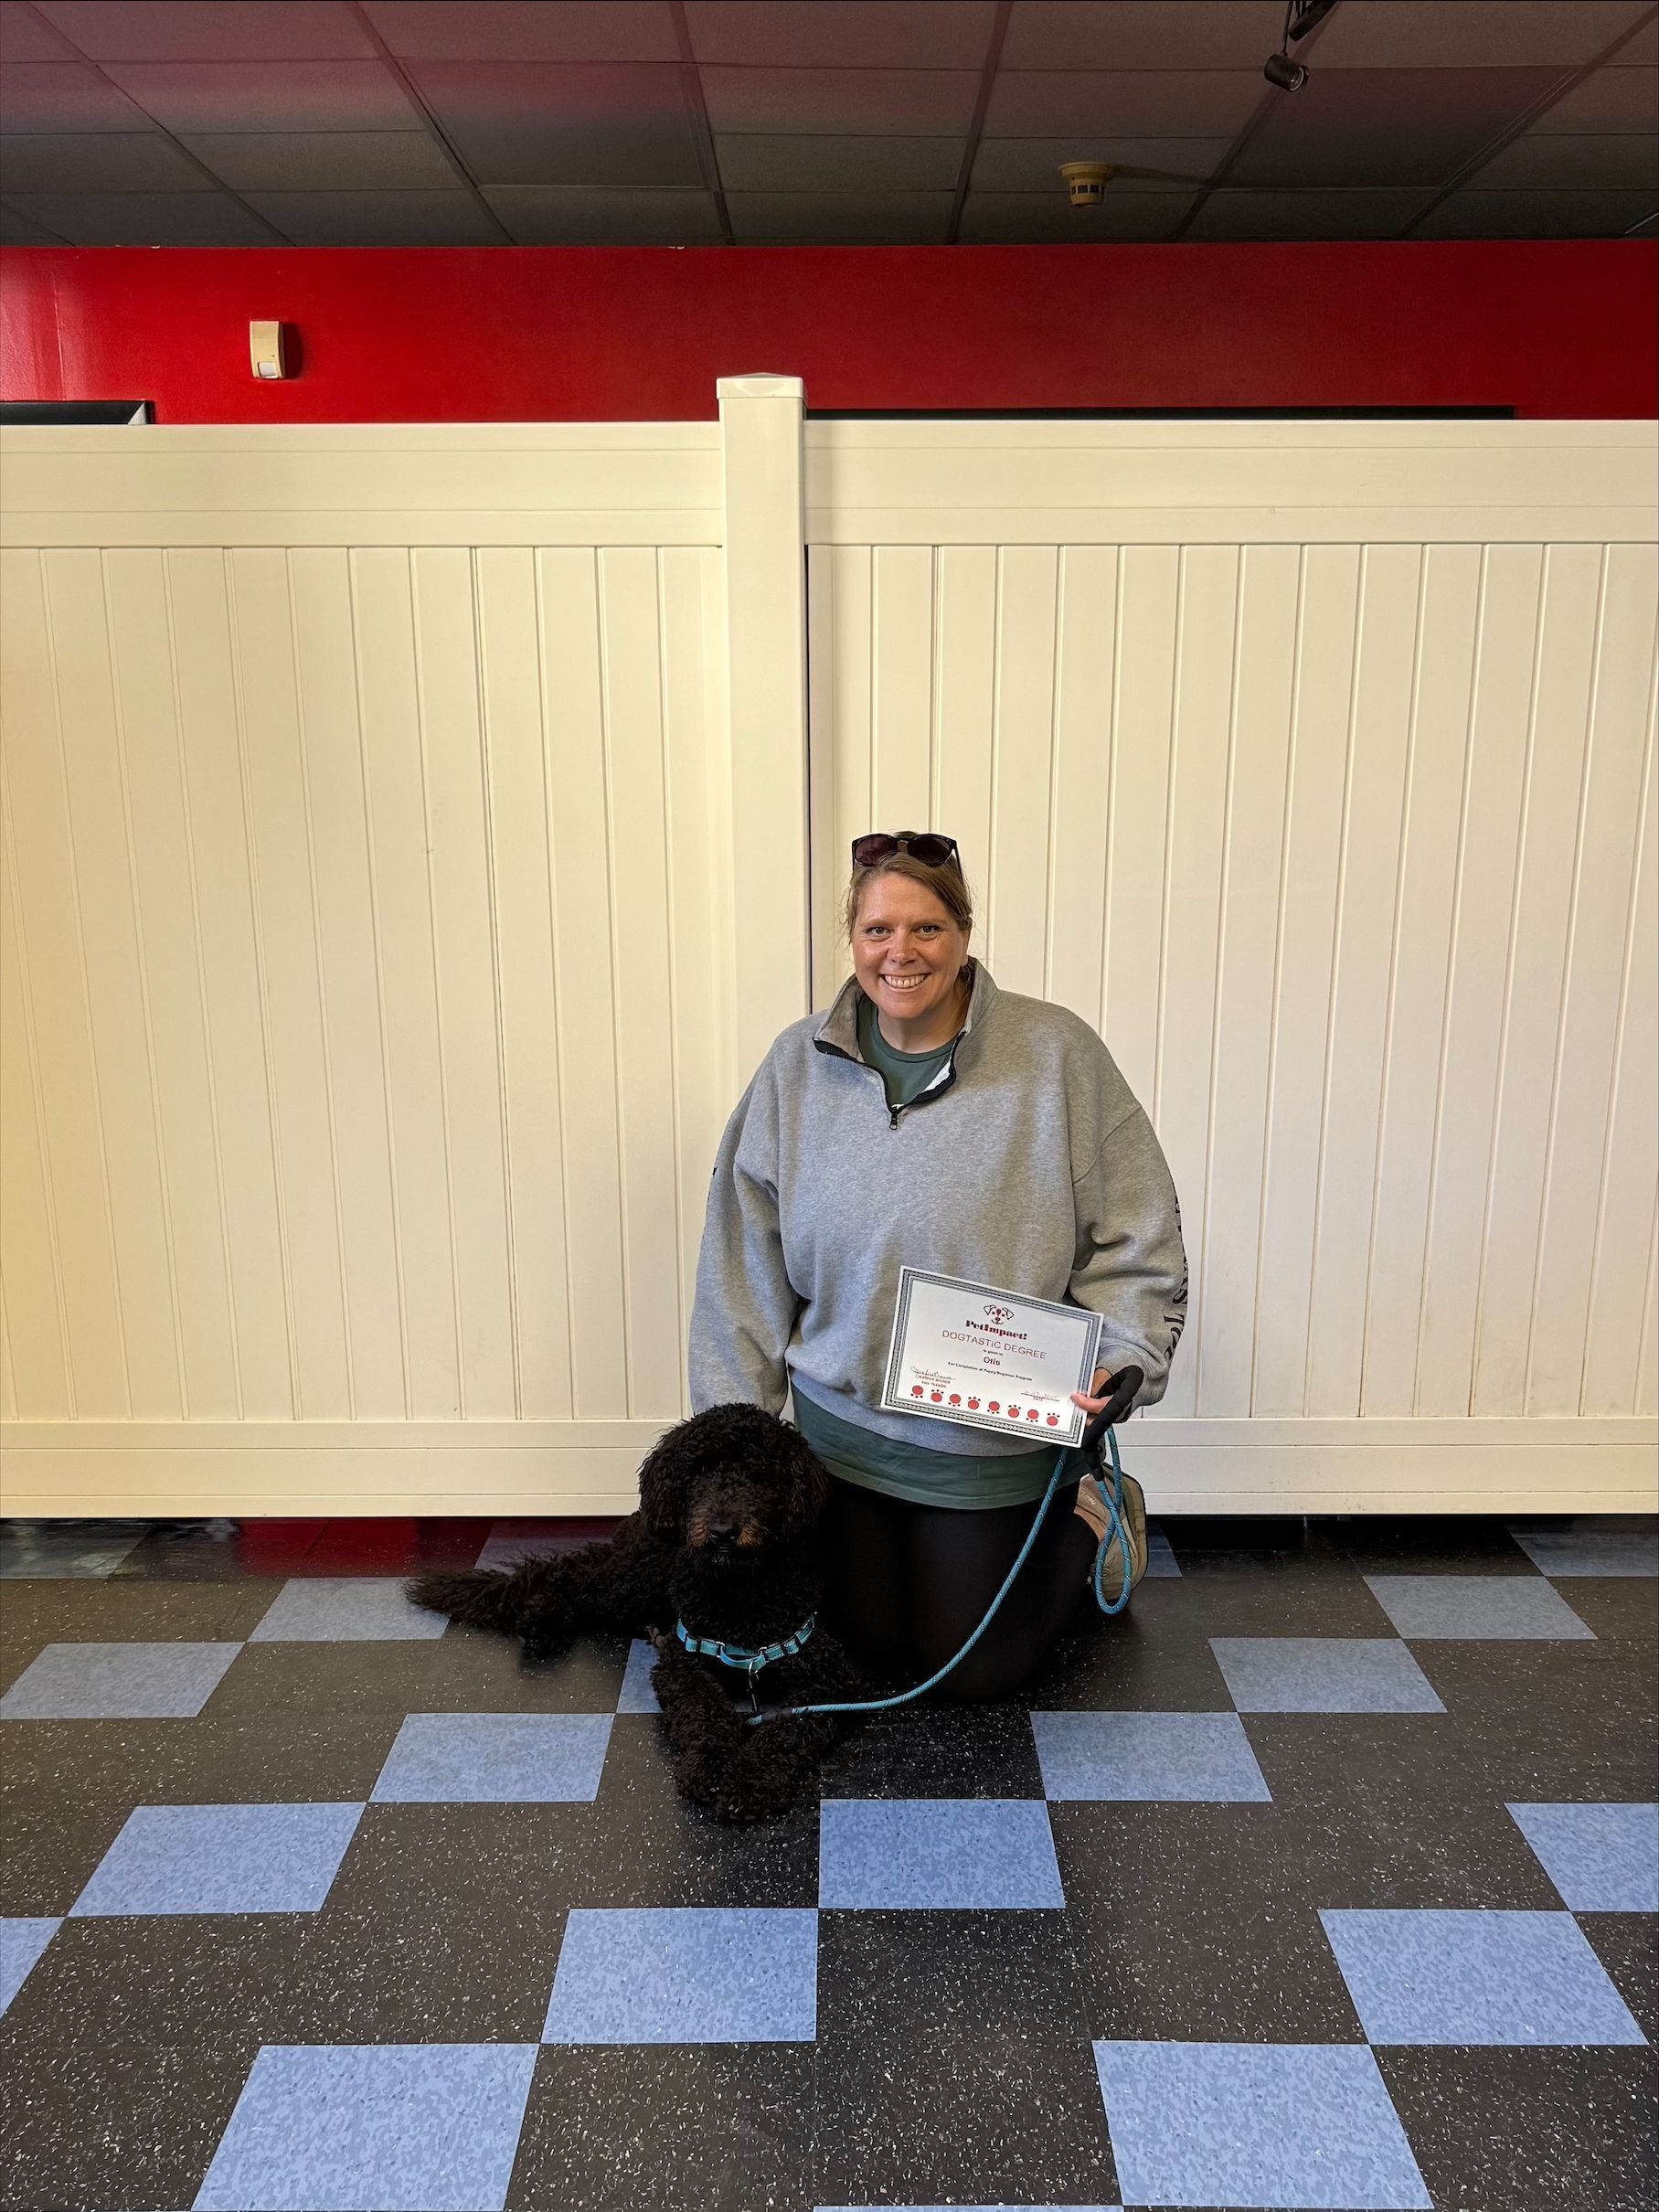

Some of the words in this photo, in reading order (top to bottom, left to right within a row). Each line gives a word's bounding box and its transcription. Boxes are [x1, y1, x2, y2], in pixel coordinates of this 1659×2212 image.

[942, 1330, 1001, 1348] DOGTASTIC
[1004, 1343, 1047, 1359] DEGREE
[984, 1356, 1001, 1366] Otis
